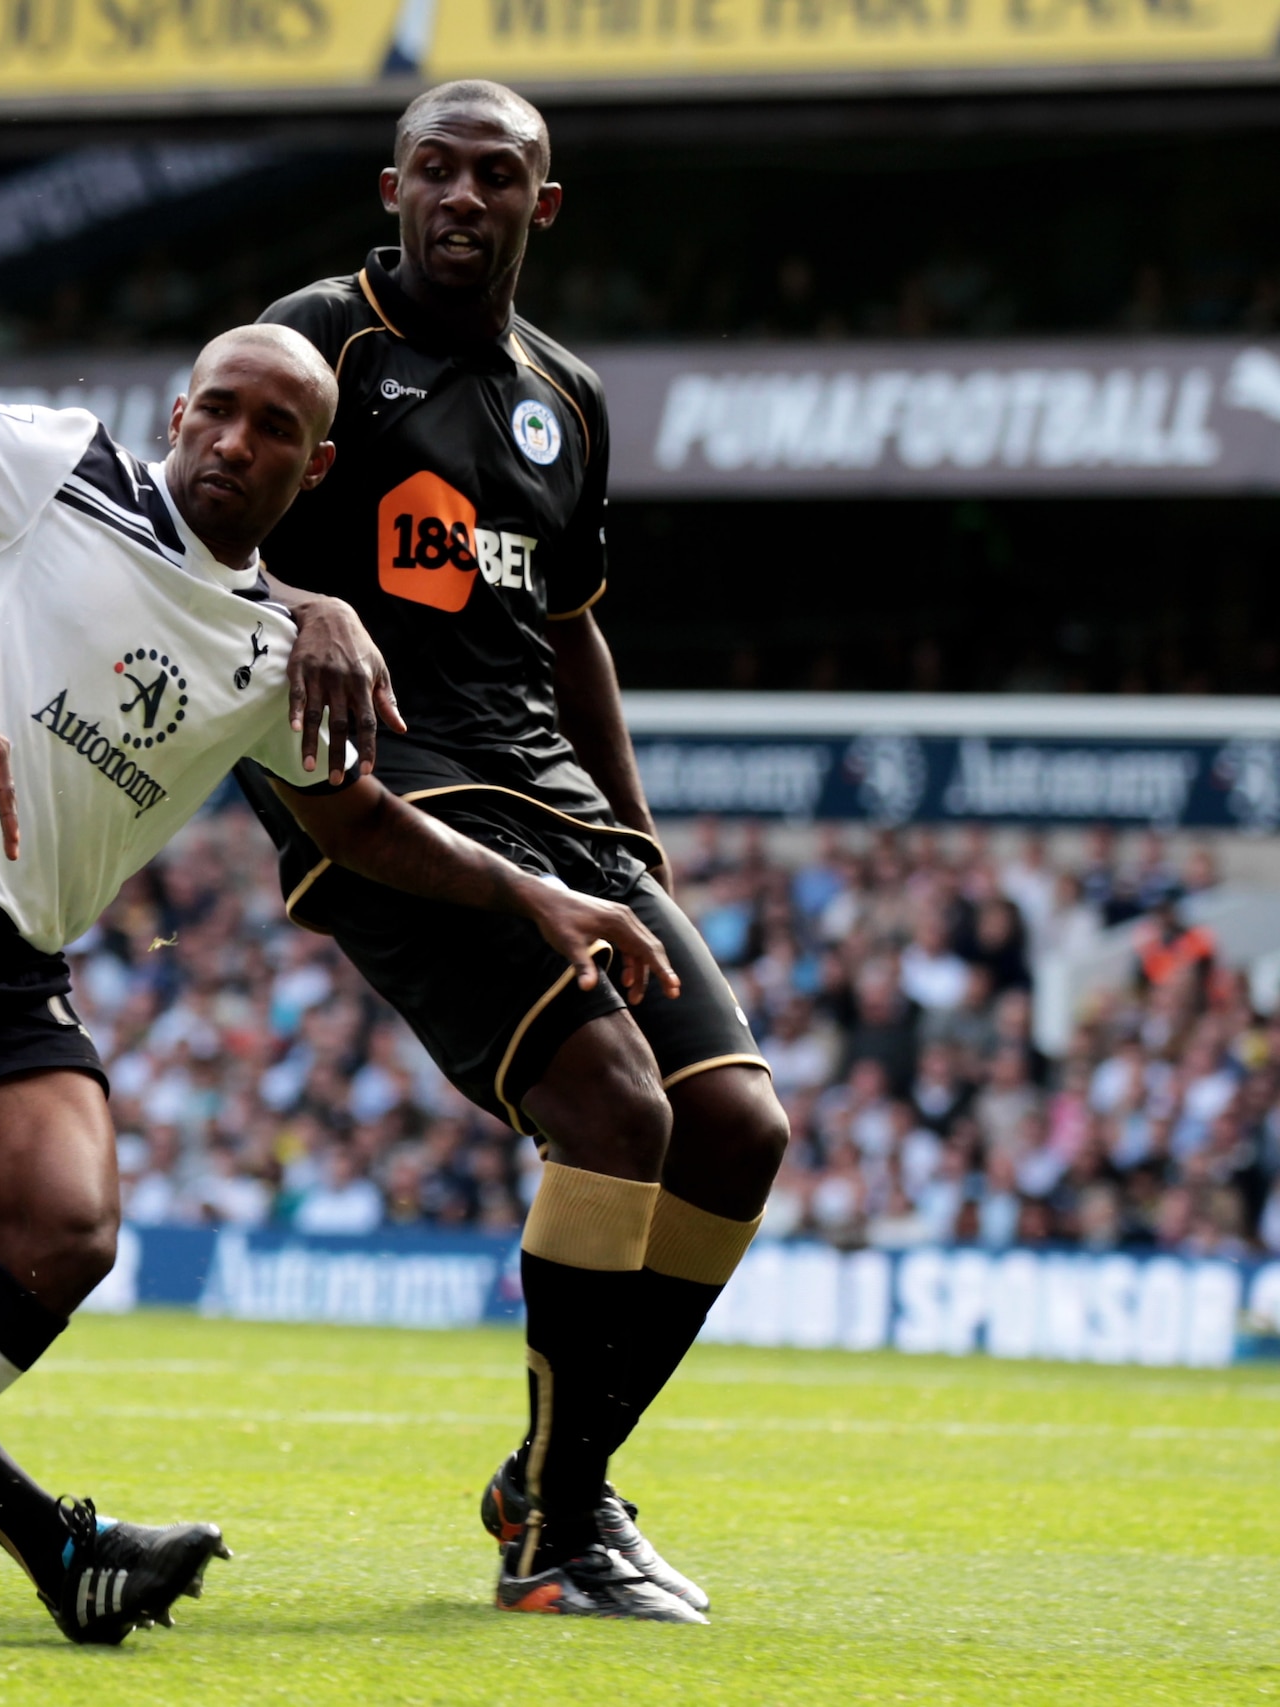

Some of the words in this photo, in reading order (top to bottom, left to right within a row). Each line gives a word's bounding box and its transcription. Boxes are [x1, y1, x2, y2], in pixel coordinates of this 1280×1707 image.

[84, 0, 332, 60] SPURS
[654, 368, 1219, 470] PUMAFOOTBALL
[31, 688, 167, 818] Autonomy
[894, 1248, 1240, 1366] SPONSOR
